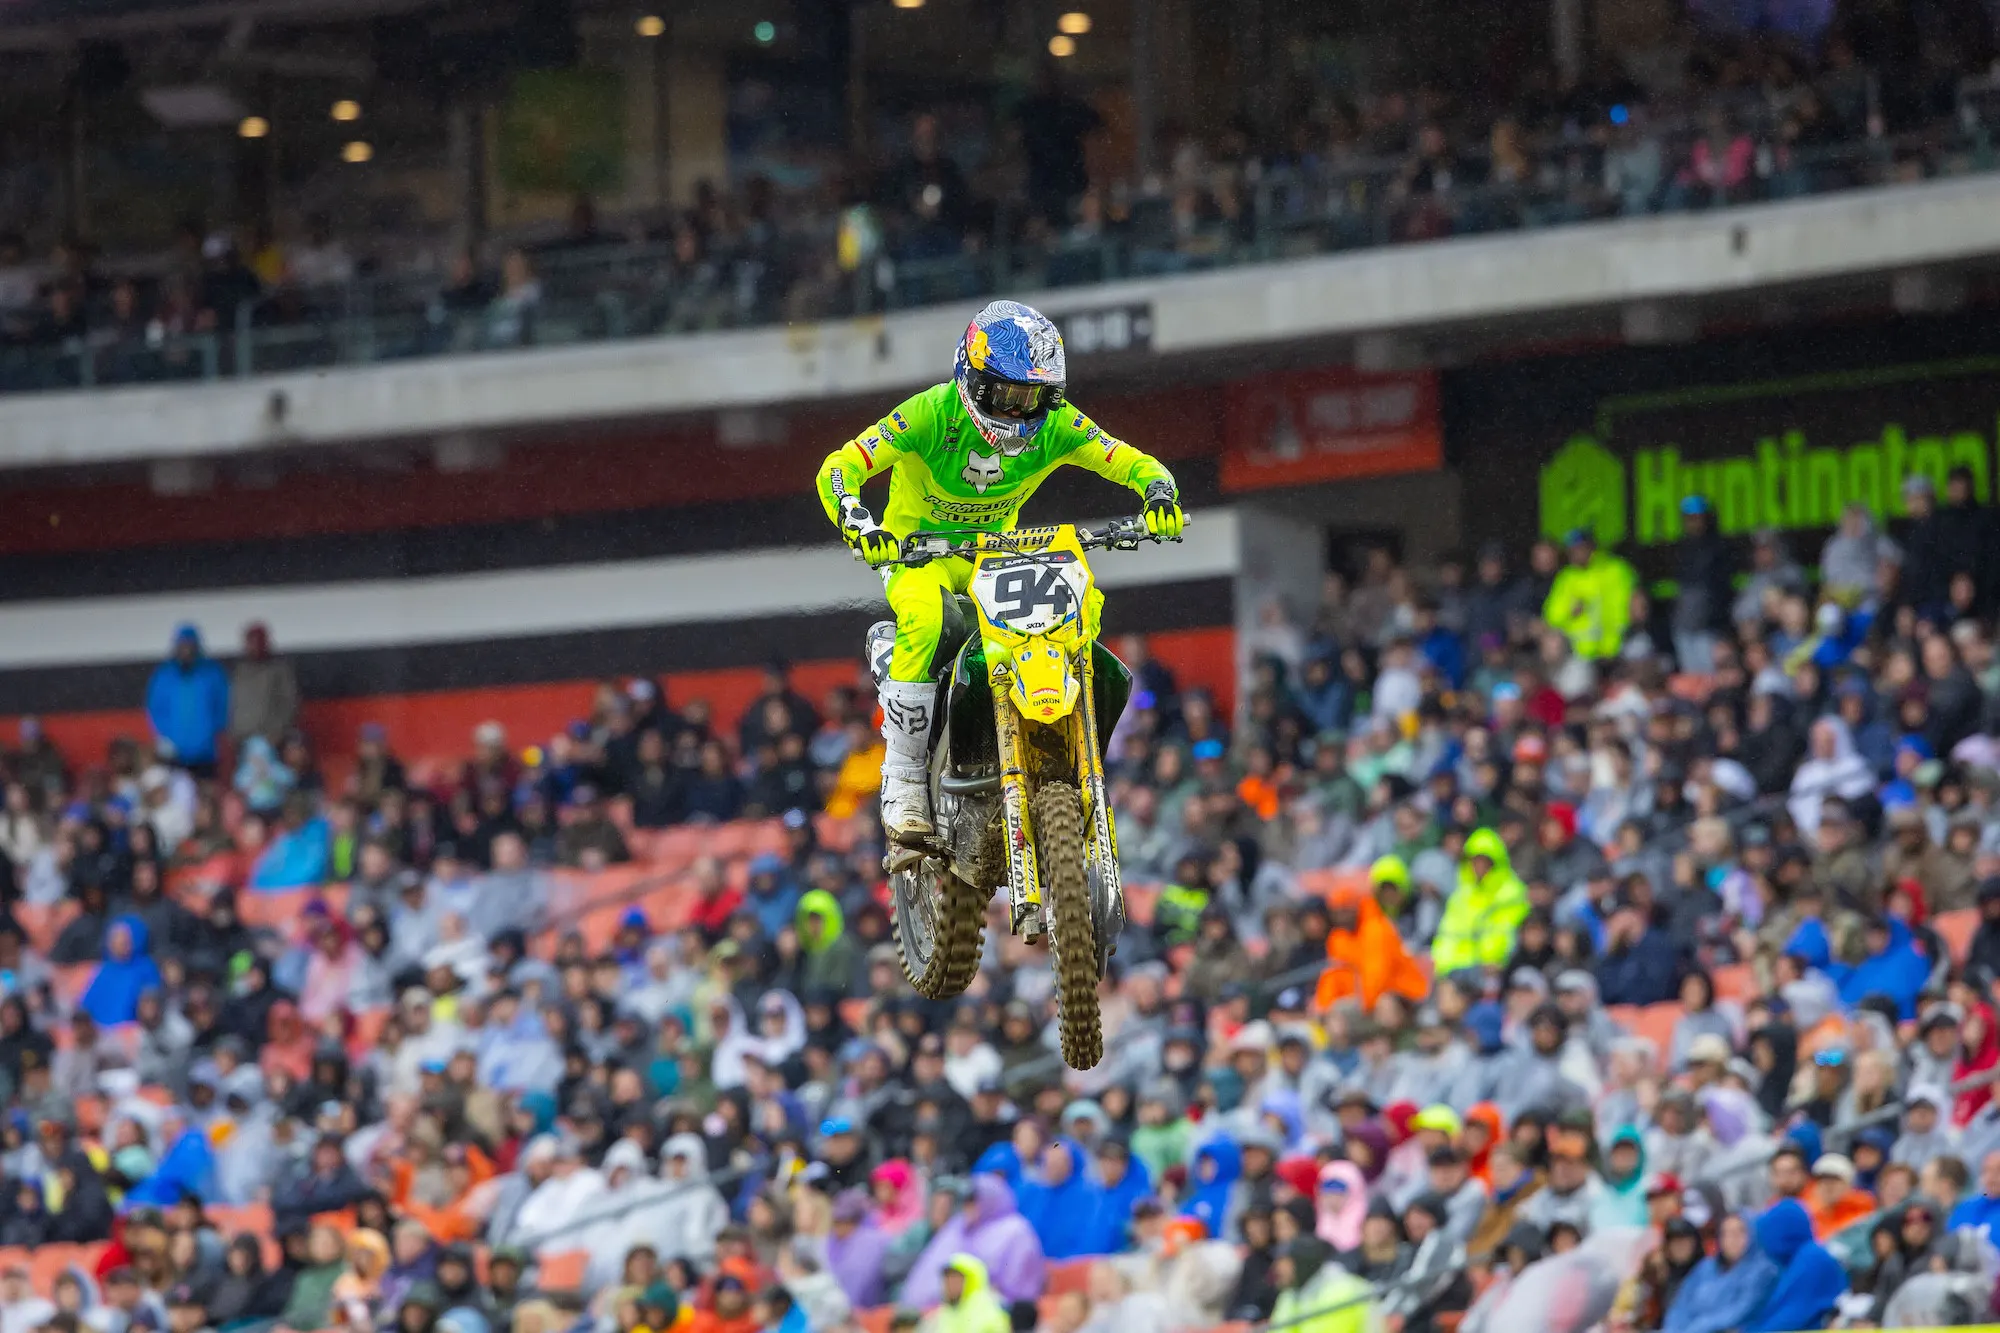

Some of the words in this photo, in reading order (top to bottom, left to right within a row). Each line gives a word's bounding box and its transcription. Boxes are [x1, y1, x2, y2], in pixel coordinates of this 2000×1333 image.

[976, 384, 986, 401] FOX
[1052, 387, 1063, 404] FOX
[1634, 422, 1990, 545] Huntington
[930, 505, 1016, 525] SUZUKI
[1116, 540, 1138, 548] ASV
[994, 567, 1072, 620] 94
[1033, 698, 1060, 707] DIXXON
[1009, 814, 1027, 900] DUNLOP
